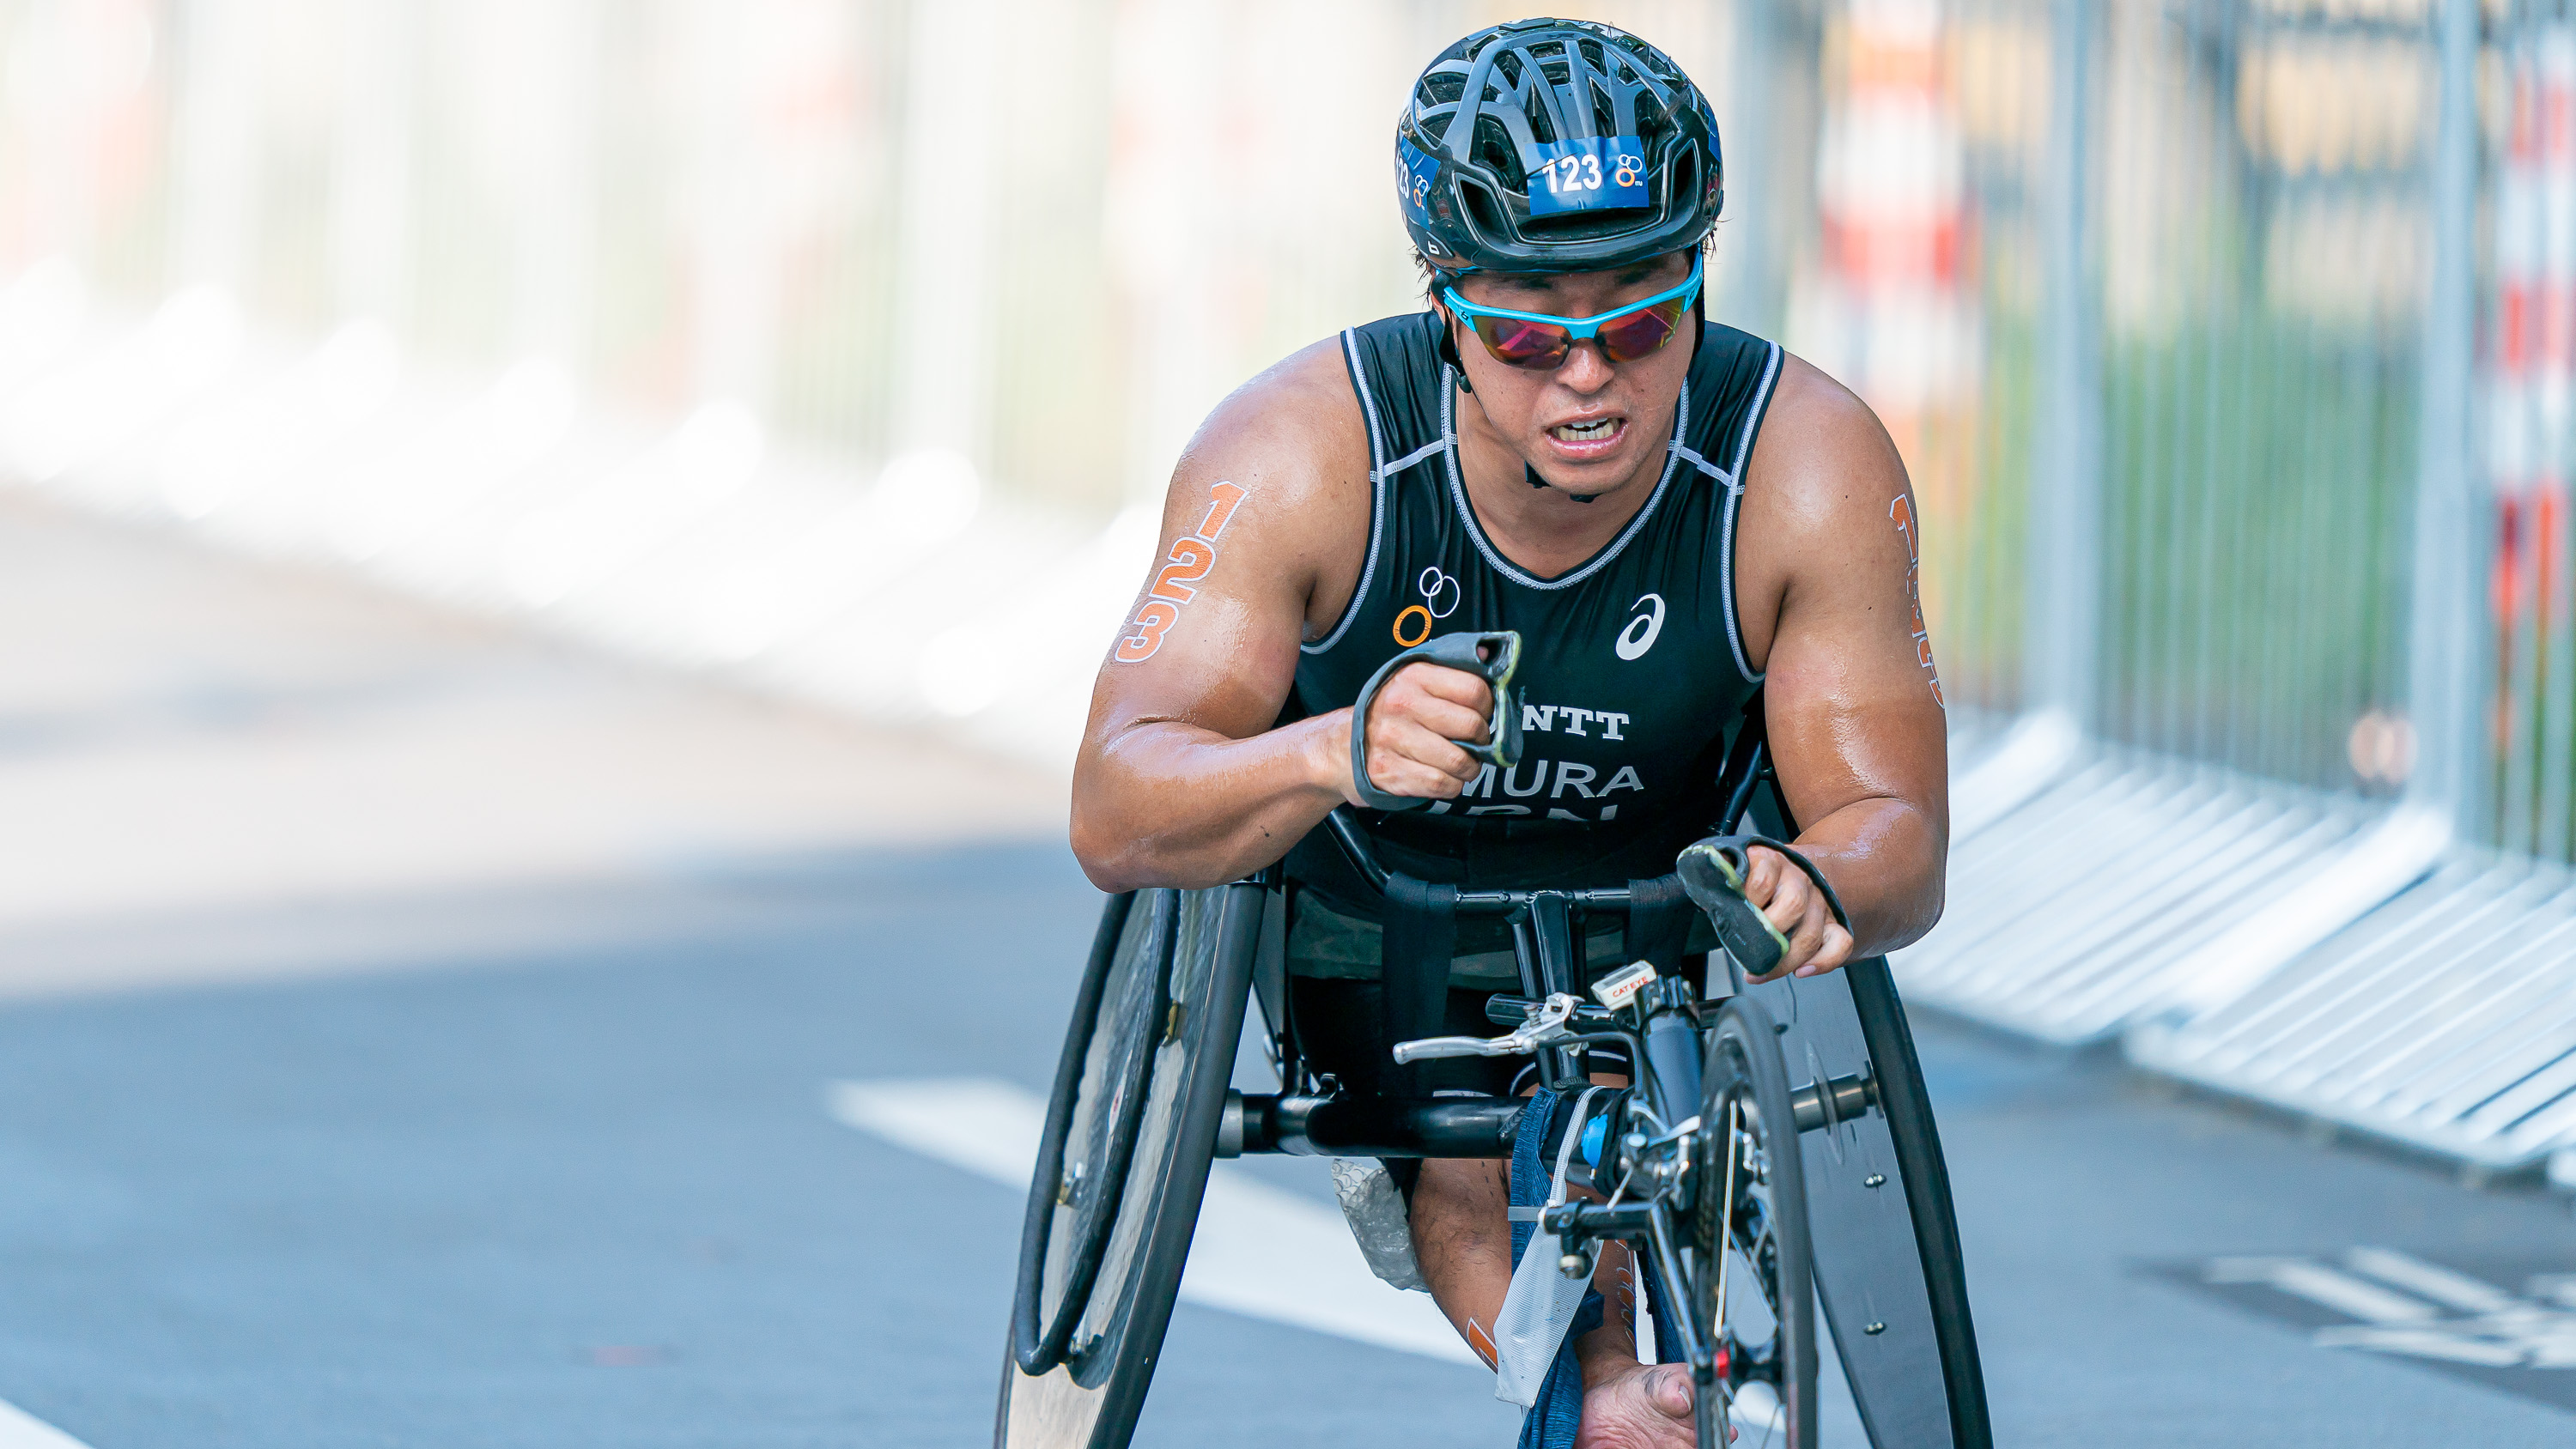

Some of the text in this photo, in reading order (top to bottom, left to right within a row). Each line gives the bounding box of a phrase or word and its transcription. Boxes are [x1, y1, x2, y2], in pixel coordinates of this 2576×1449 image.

[1541, 154, 1602, 194] 123
[1115, 480, 1250, 663] 123
[1522, 705, 1630, 741] NTT
[1613, 985, 1628, 997] CAT
